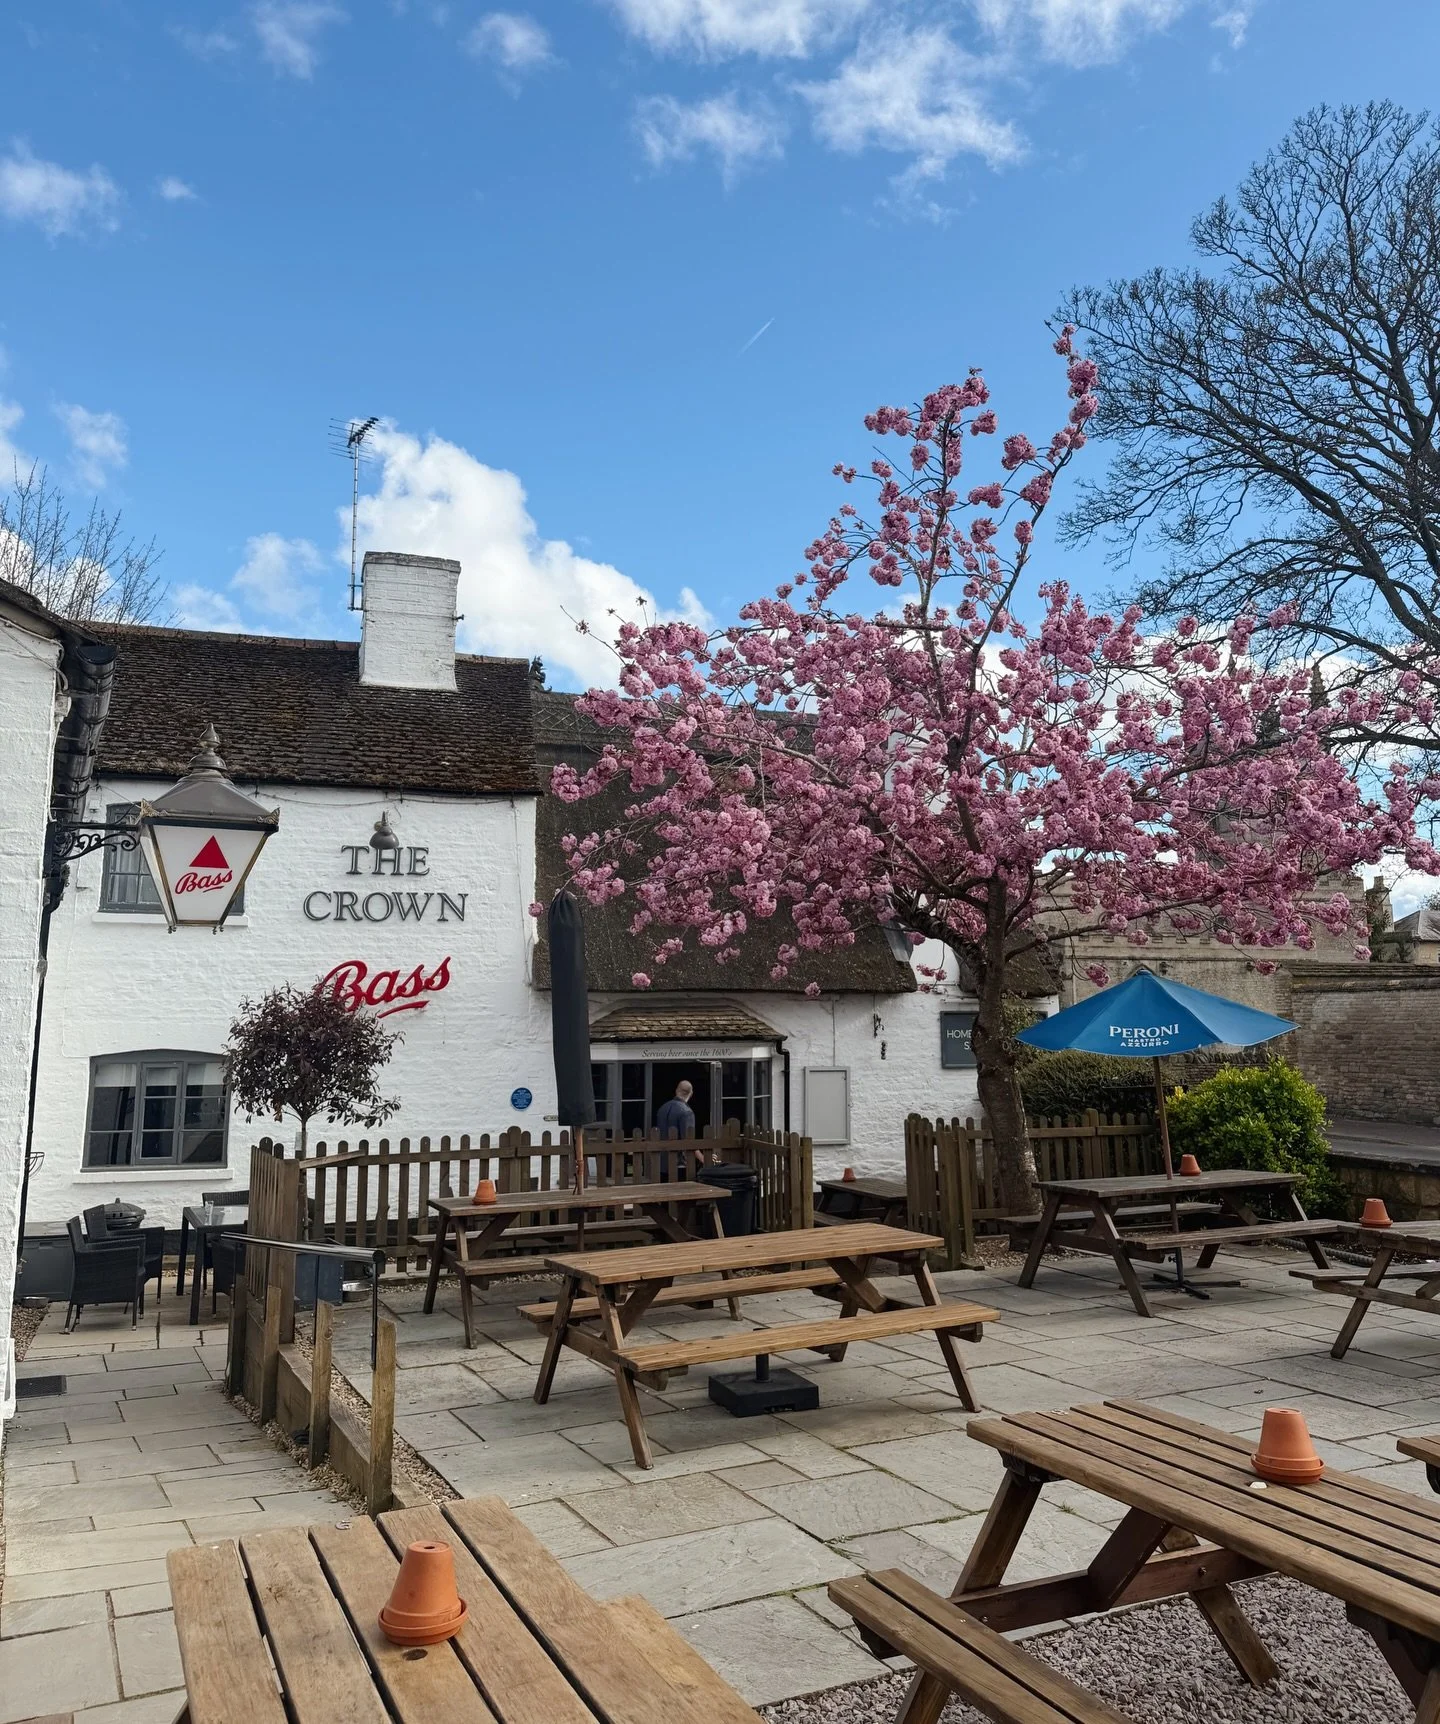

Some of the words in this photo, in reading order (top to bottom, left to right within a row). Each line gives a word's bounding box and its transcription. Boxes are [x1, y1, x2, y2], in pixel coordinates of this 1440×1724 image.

[341, 845, 430, 876] THE
[175, 870, 233, 895] Bass
[303, 891, 469, 922] CROWN
[315, 957, 451, 1013] Bass
[1109, 1023, 1179, 1039] PERONI
[642, 1049, 667, 1058] Serving
[668, 1049, 681, 1057] beer
[683, 1049, 699, 1057] since
[700, 1048, 711, 1057] the
[1120, 1040, 1170, 1048] AZZURRO
